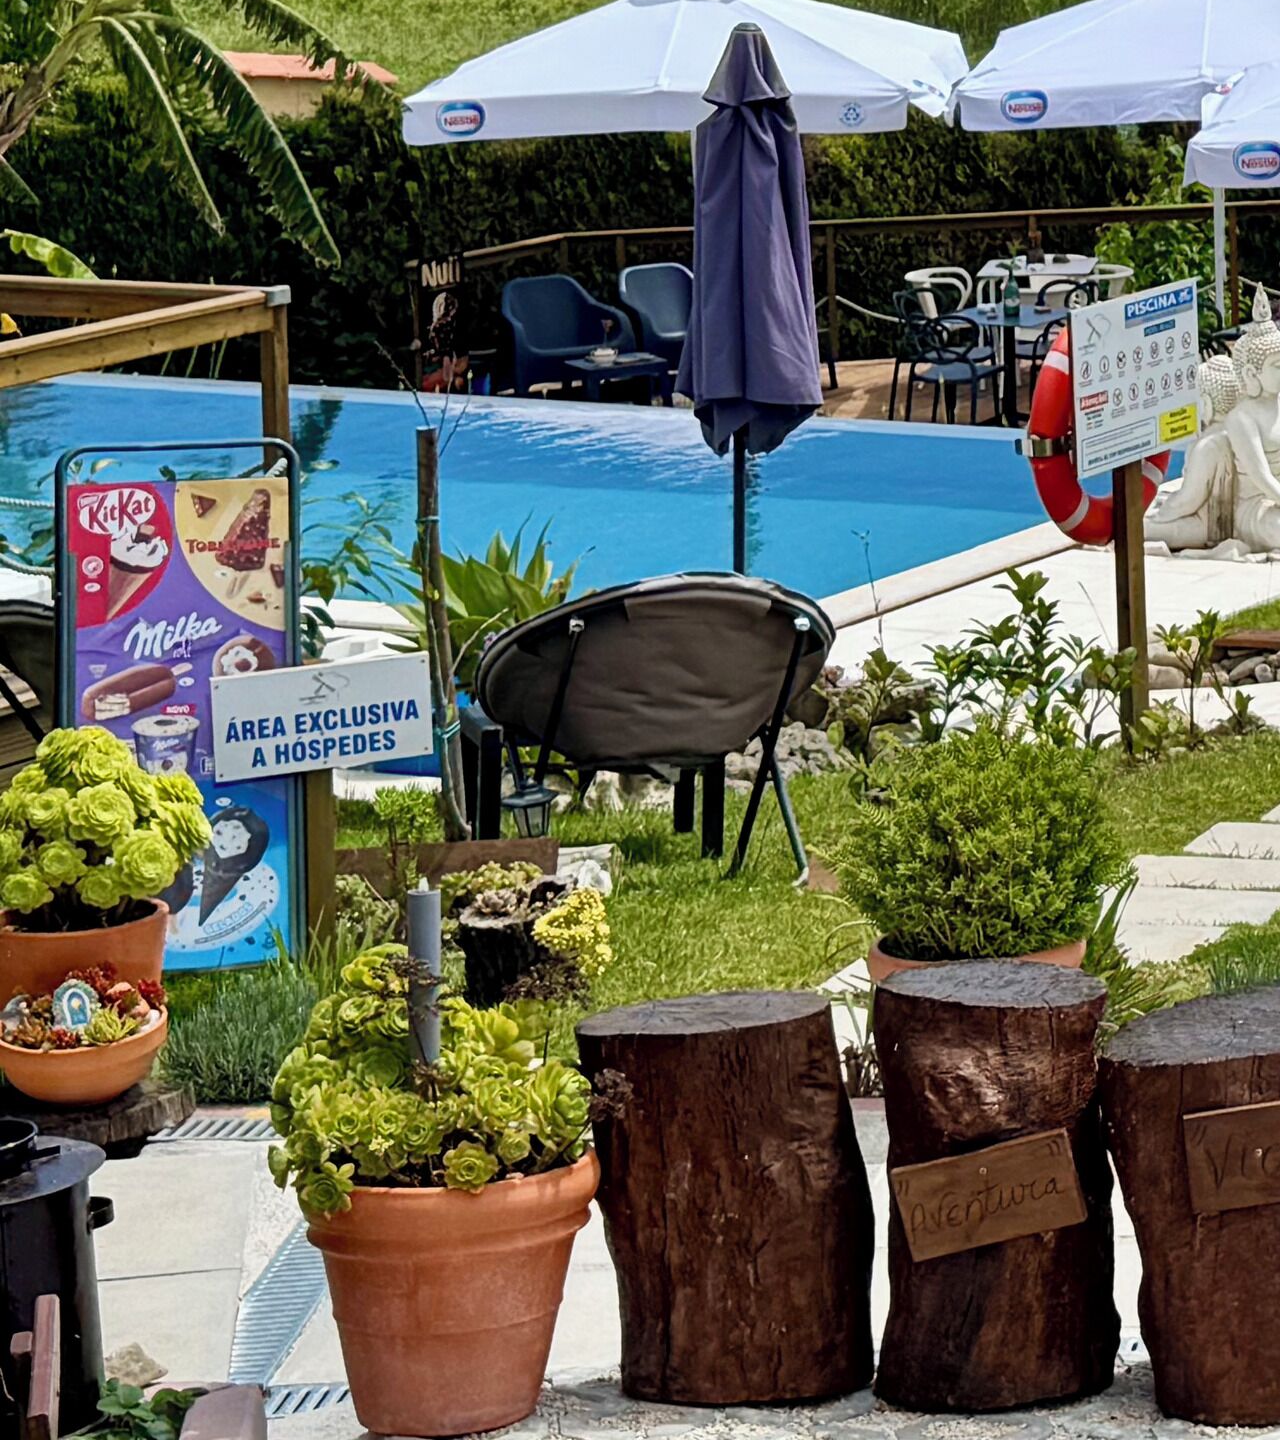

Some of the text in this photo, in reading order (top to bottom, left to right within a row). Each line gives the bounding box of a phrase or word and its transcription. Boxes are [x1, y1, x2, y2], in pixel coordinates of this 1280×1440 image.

[1127, 294, 1177, 317] PISCINA
[124, 612, 223, 660] Milka
[226, 699, 419, 744] ÁREA EXCLUSIVA
[252, 729, 396, 768] A HÓSPEDES
